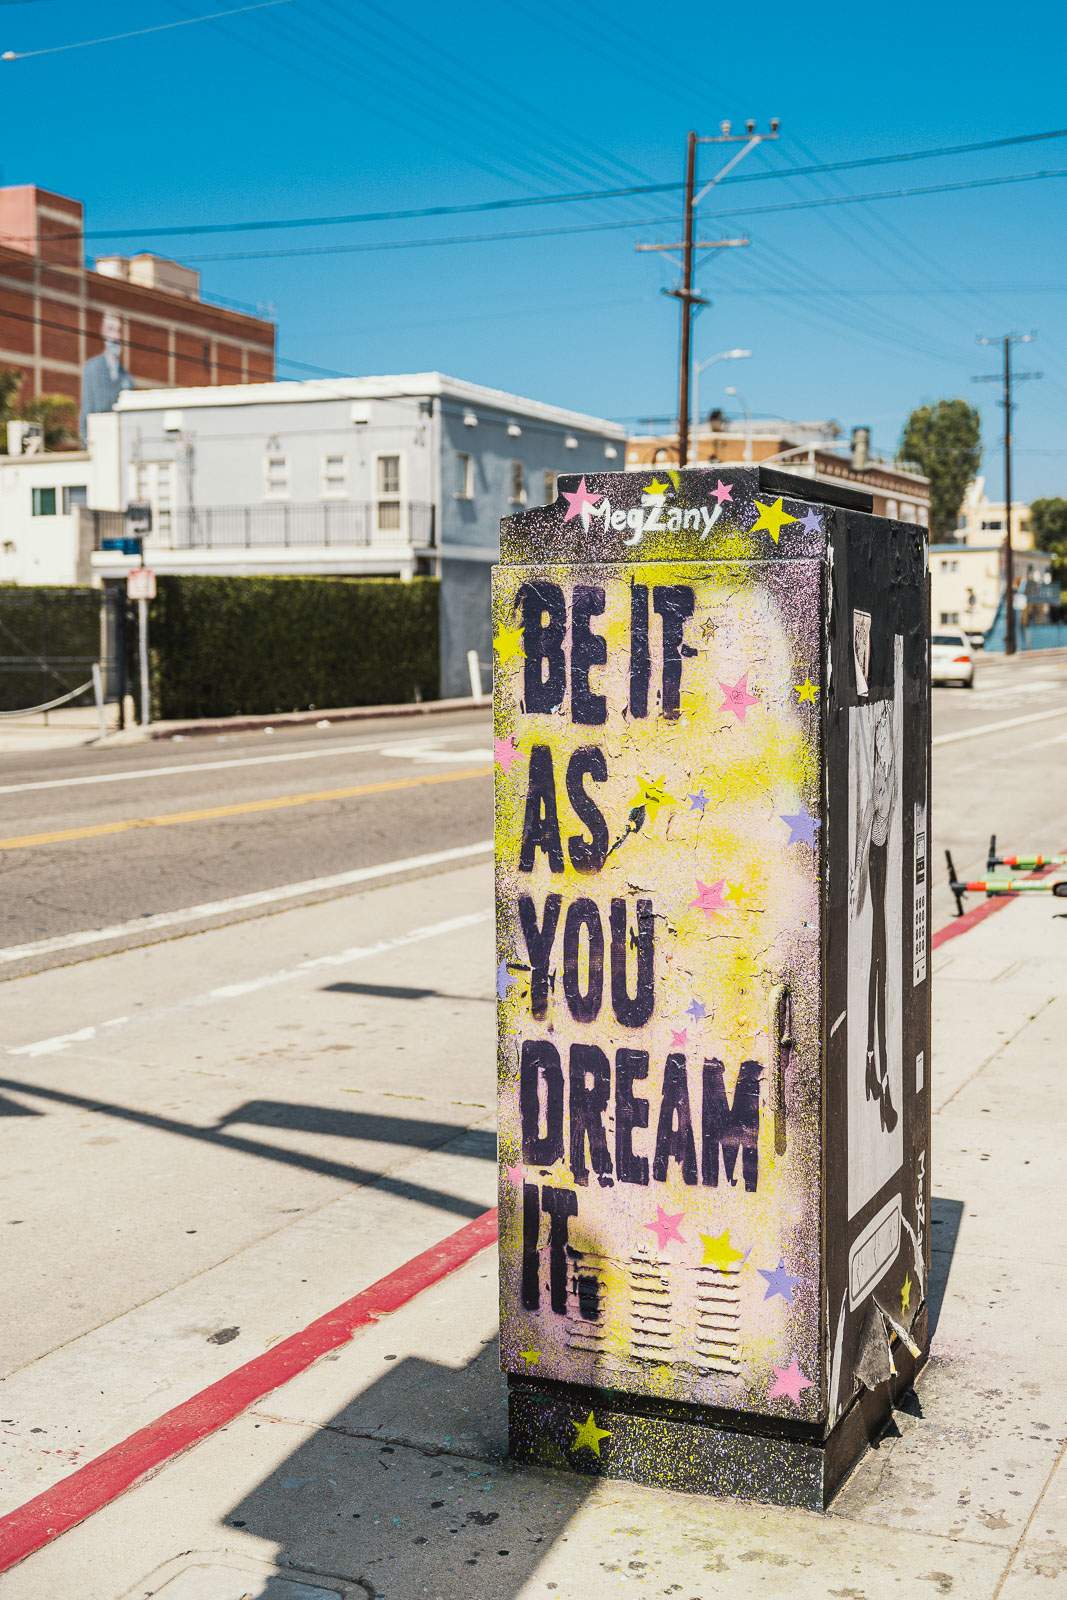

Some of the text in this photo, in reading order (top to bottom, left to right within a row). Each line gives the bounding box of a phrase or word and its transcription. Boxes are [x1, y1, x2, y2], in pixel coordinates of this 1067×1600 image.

[580, 494, 723, 546] MegZany
[516, 579, 696, 725] BE IT
[519, 744, 609, 874] AS
[519, 893, 656, 1028] YOU
[520, 1039, 764, 1193] DREAM
